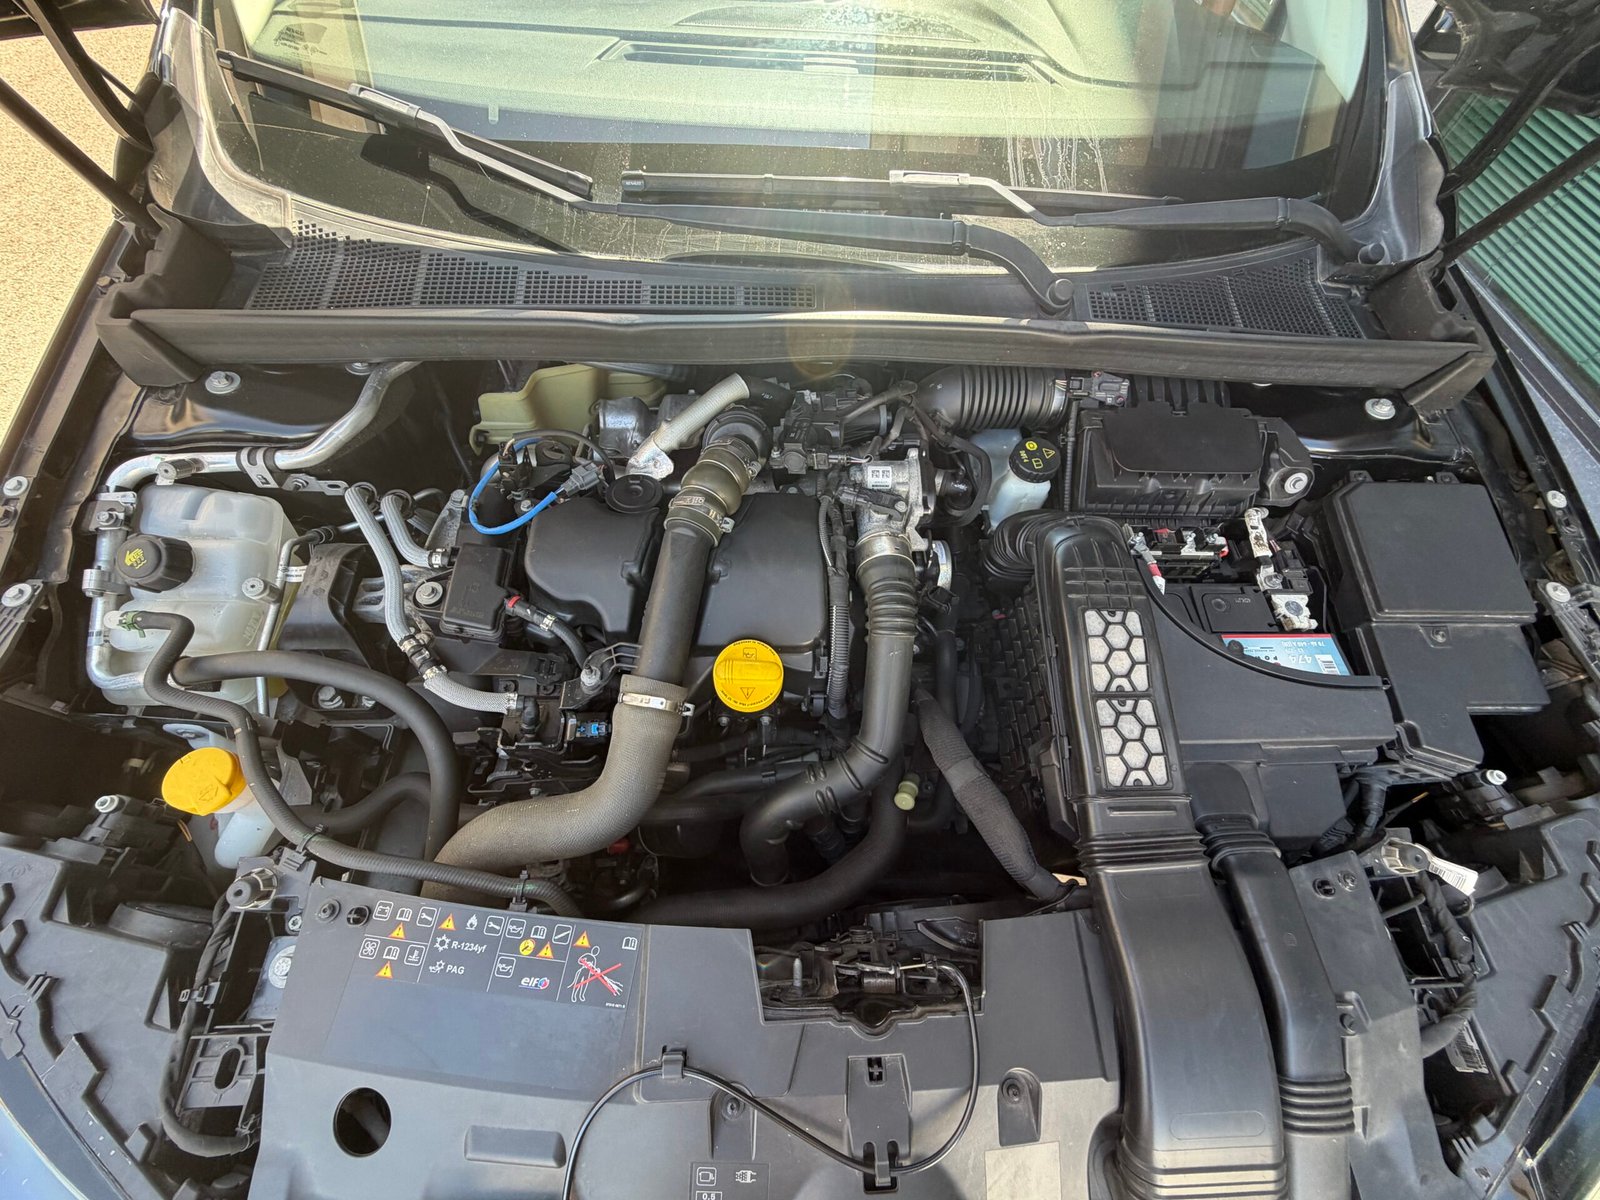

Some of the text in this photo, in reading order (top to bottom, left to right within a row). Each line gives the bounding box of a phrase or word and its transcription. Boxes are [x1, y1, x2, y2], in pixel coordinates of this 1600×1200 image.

[451, 940, 487, 954] R-1234yf
[446, 964, 465, 975] PAG
[521, 976, 541, 987] elf
